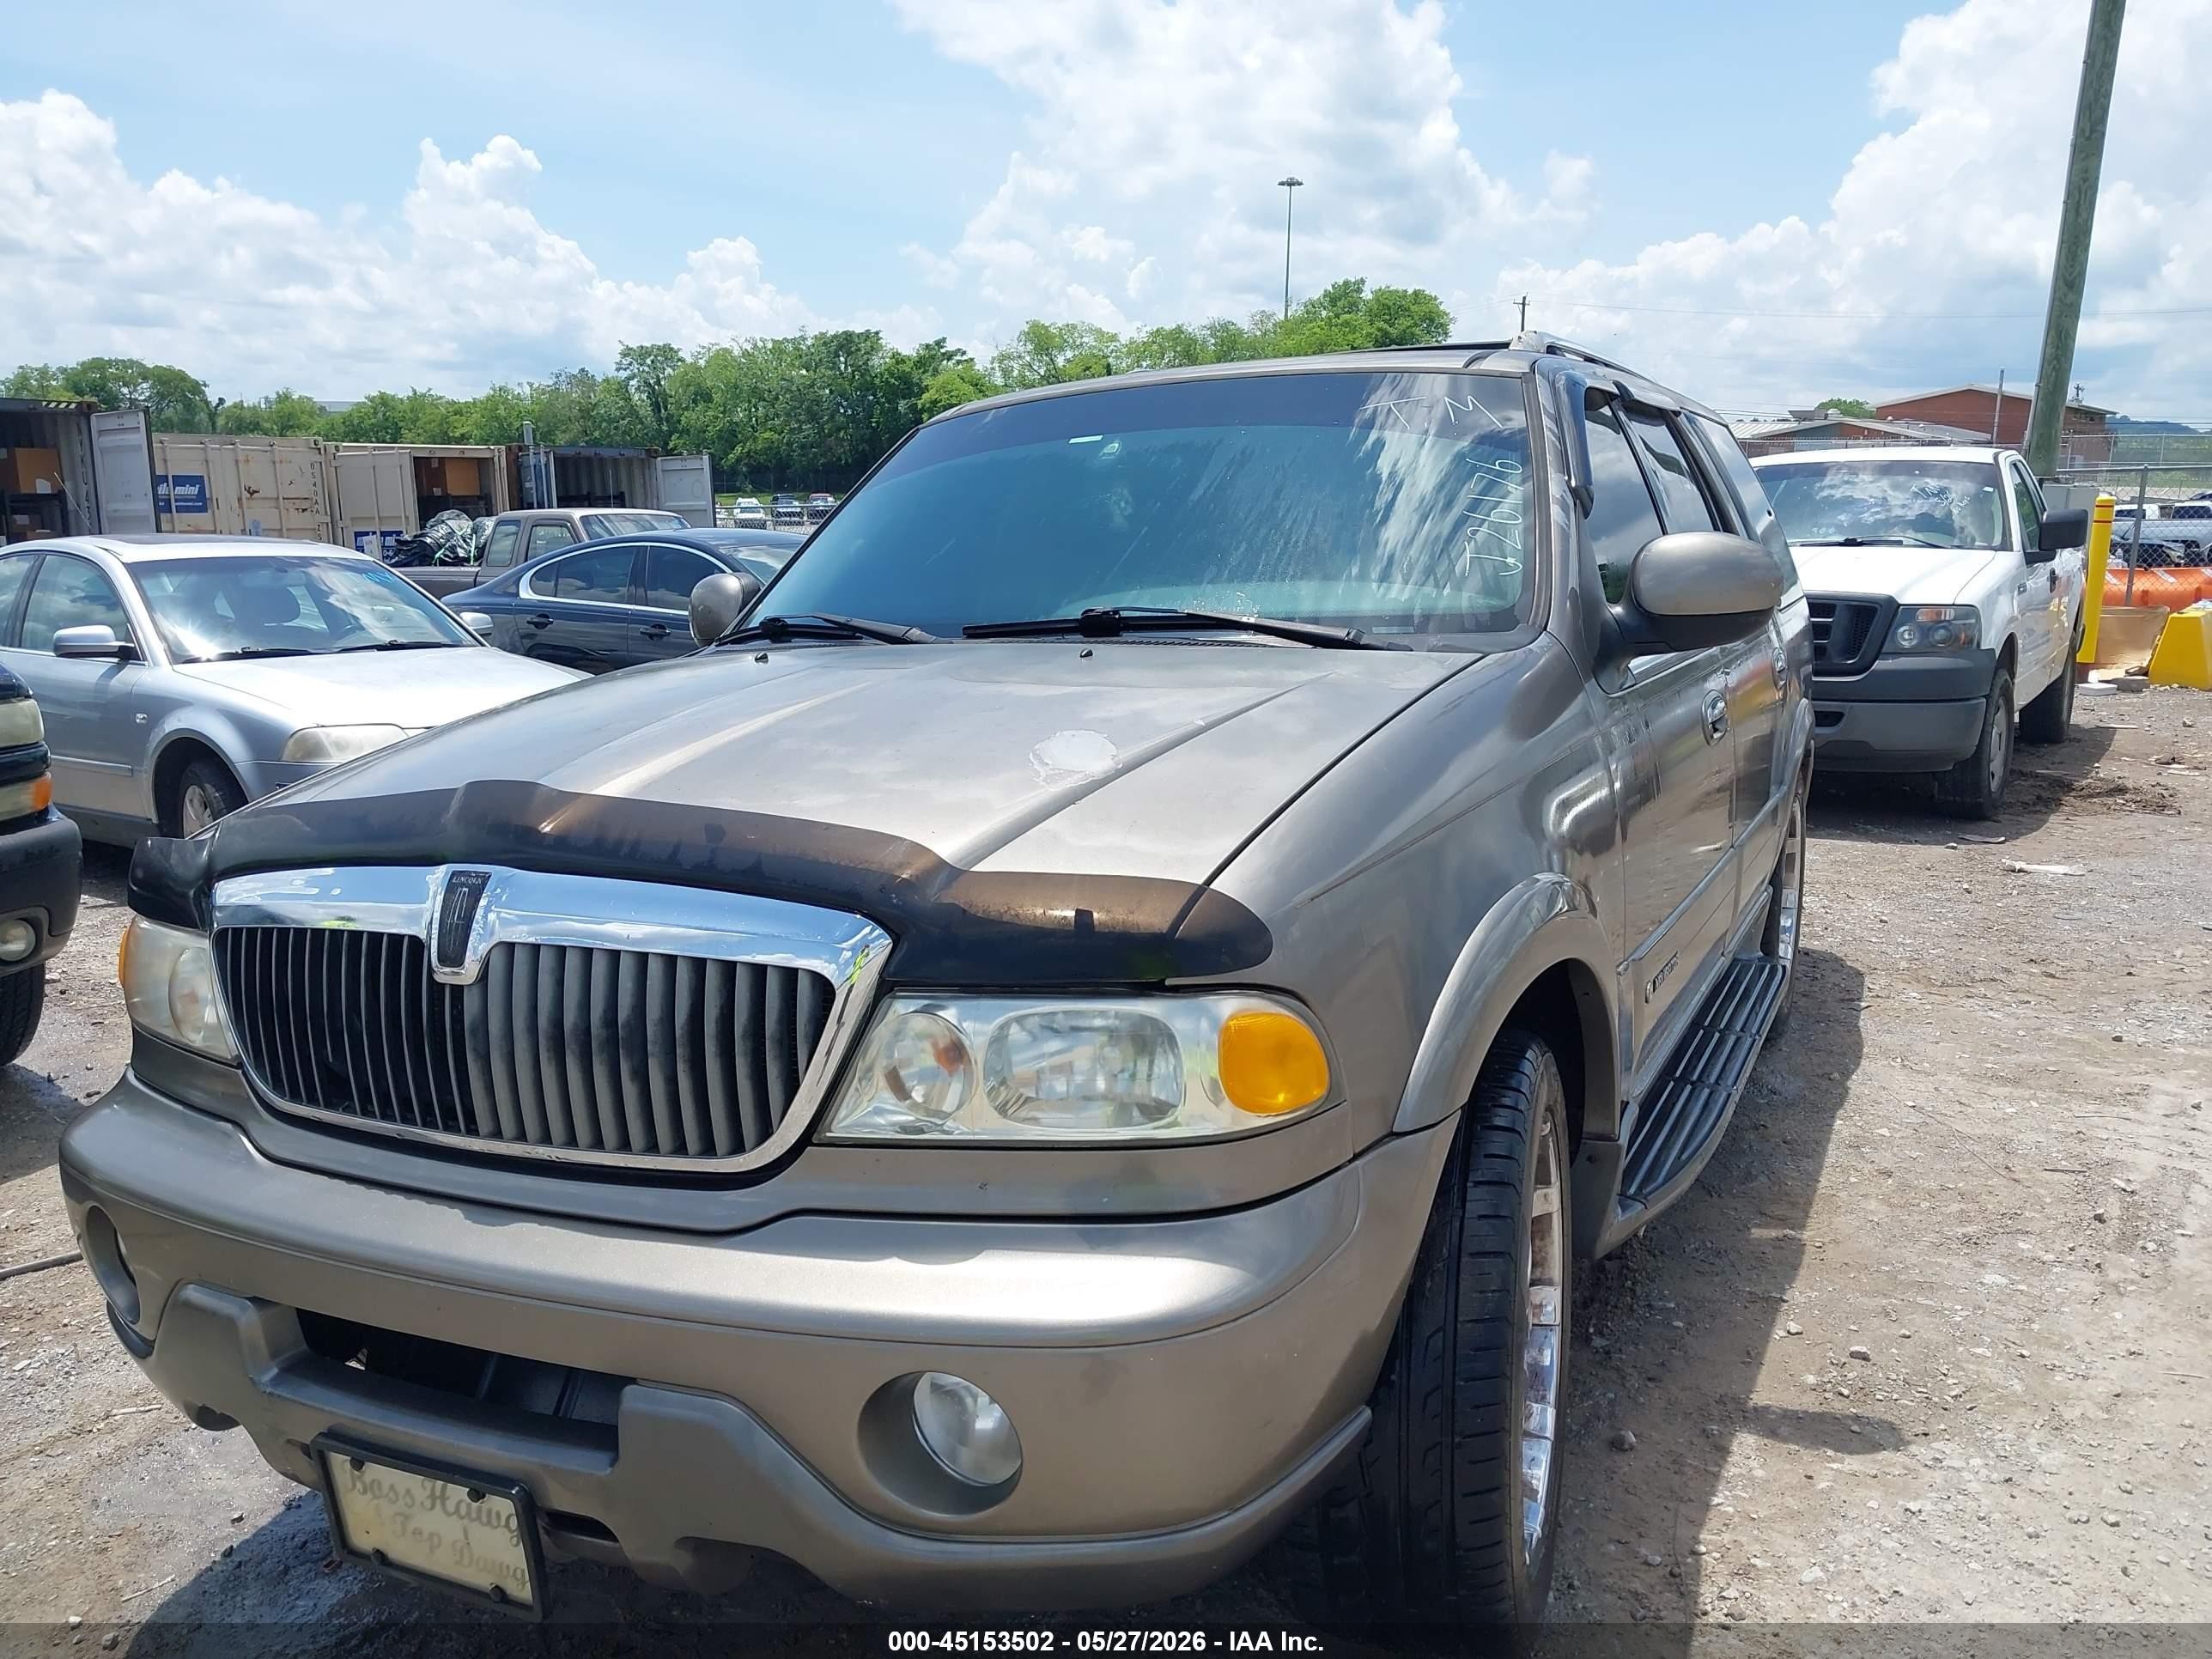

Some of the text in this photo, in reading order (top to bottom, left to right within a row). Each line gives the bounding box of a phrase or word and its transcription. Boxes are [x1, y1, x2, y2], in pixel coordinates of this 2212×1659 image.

[1463, 457, 1525, 577] J26176
[347, 1460, 520, 1547] Boss Hawg
[392, 1512, 529, 1591] Top Dawg
